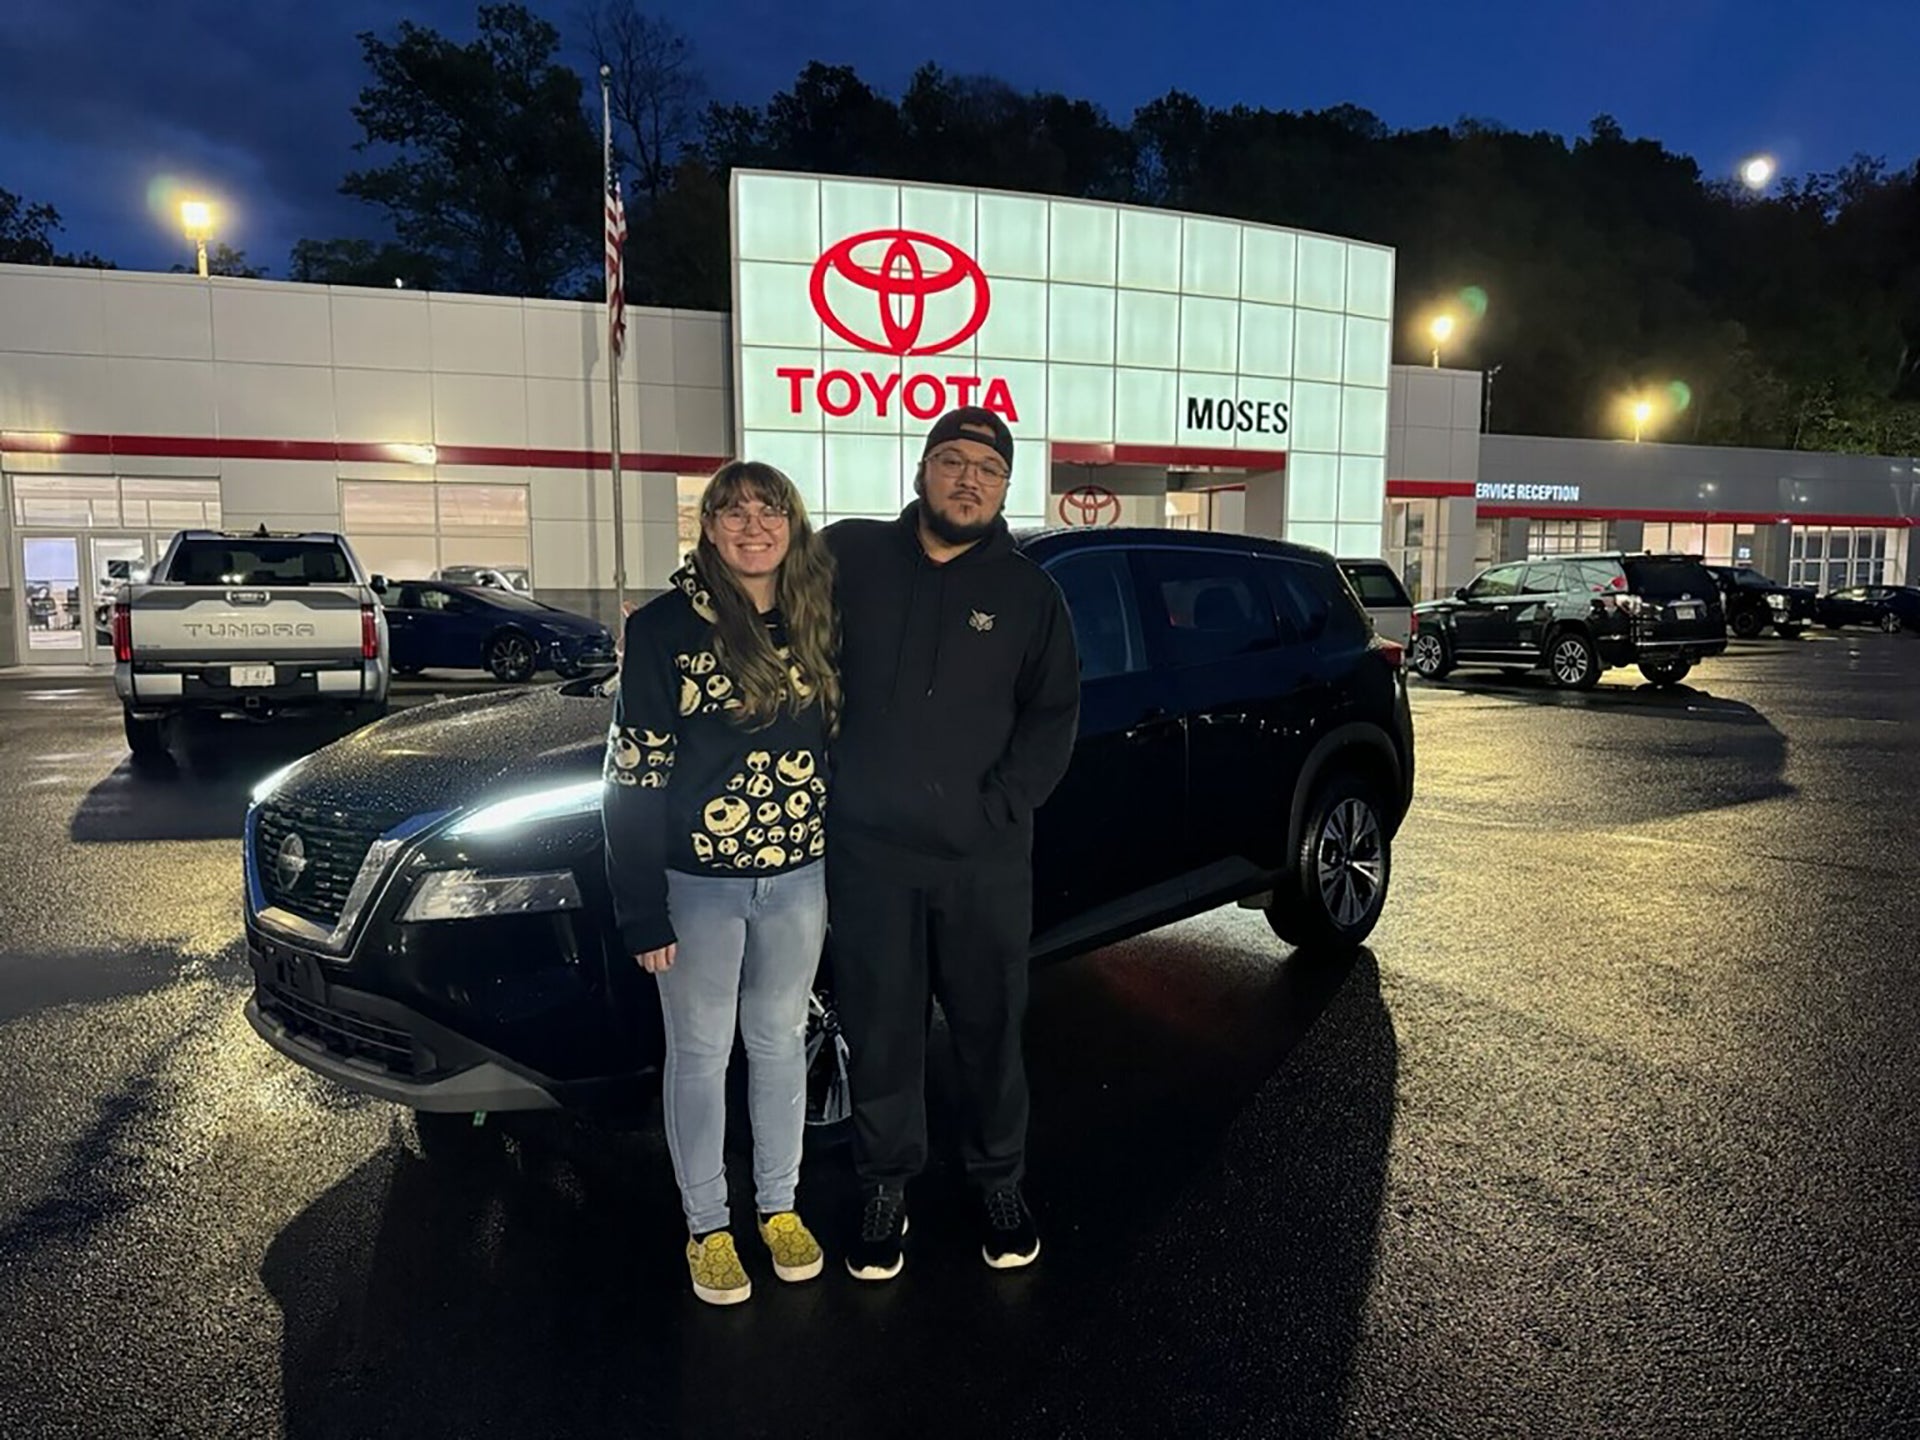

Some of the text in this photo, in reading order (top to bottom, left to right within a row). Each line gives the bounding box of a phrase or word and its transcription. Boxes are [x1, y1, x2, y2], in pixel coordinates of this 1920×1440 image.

[777, 368, 1018, 422] TOYOTA
[1187, 397, 1288, 434] MOSES
[1476, 483, 1579, 501] ERVICE RECEPTION
[182, 623, 315, 638] TUNDRA
